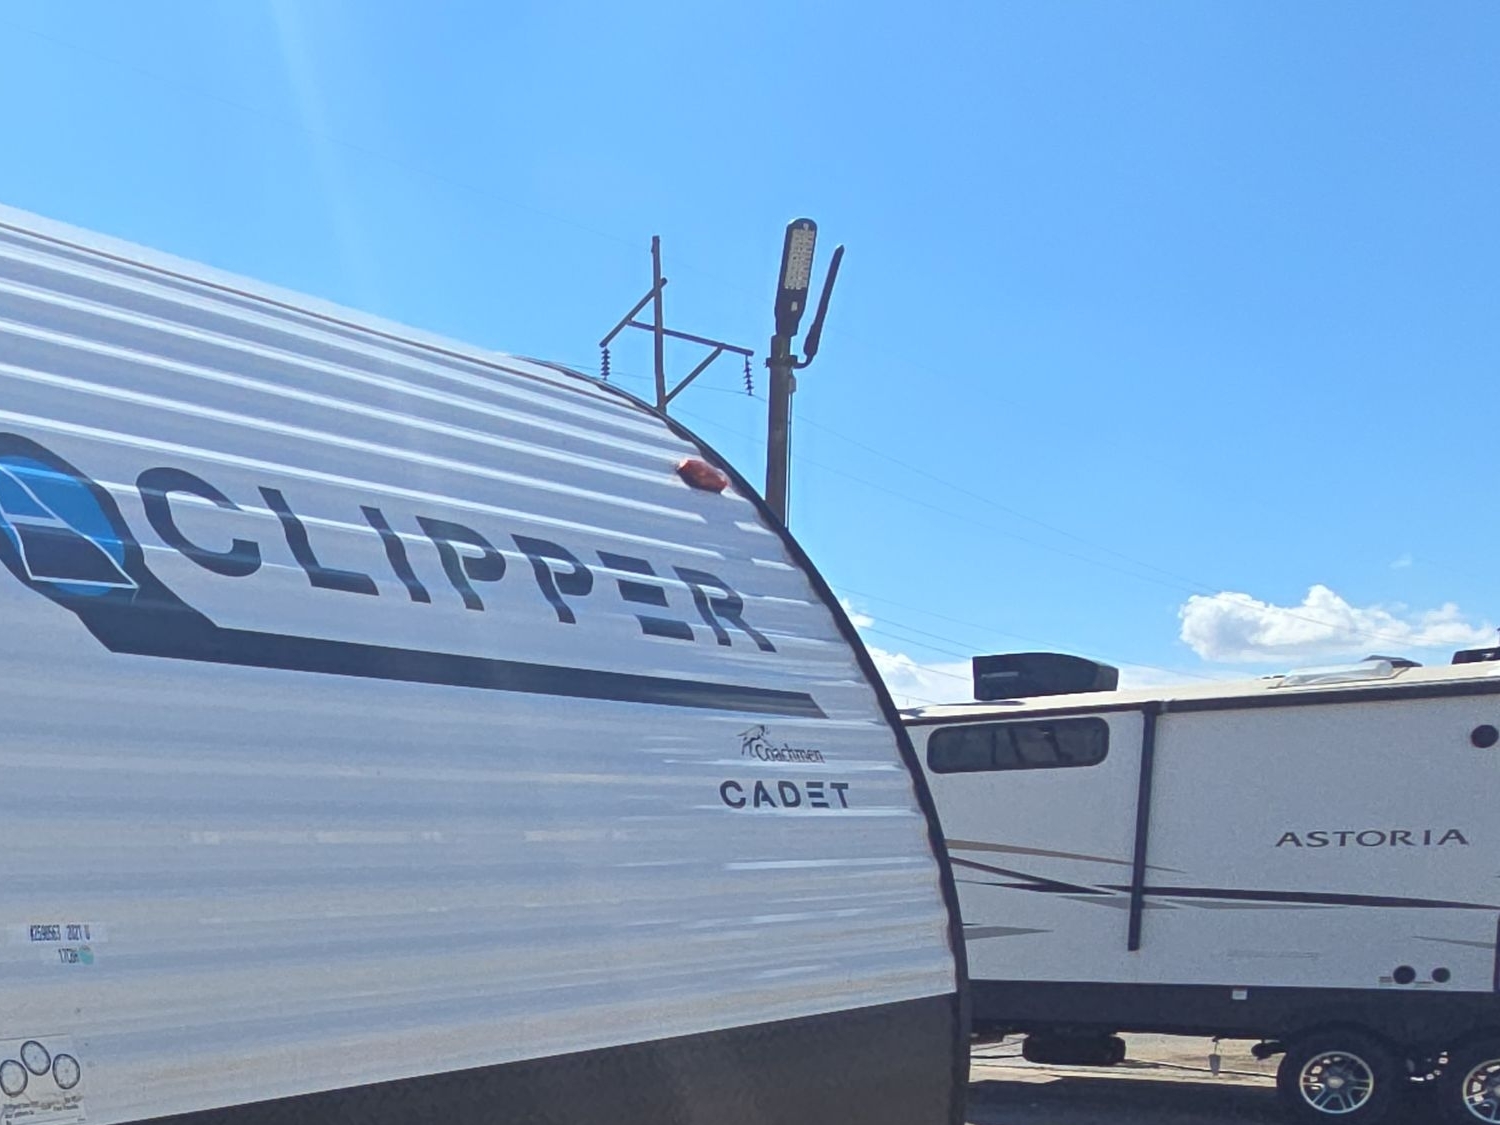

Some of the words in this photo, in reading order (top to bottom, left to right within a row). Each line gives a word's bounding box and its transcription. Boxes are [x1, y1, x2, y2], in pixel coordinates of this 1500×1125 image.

[135, 466, 777, 653] CLIPPER
[719, 779, 849, 809] CADET
[1275, 829, 1469, 848] ASTORIA
